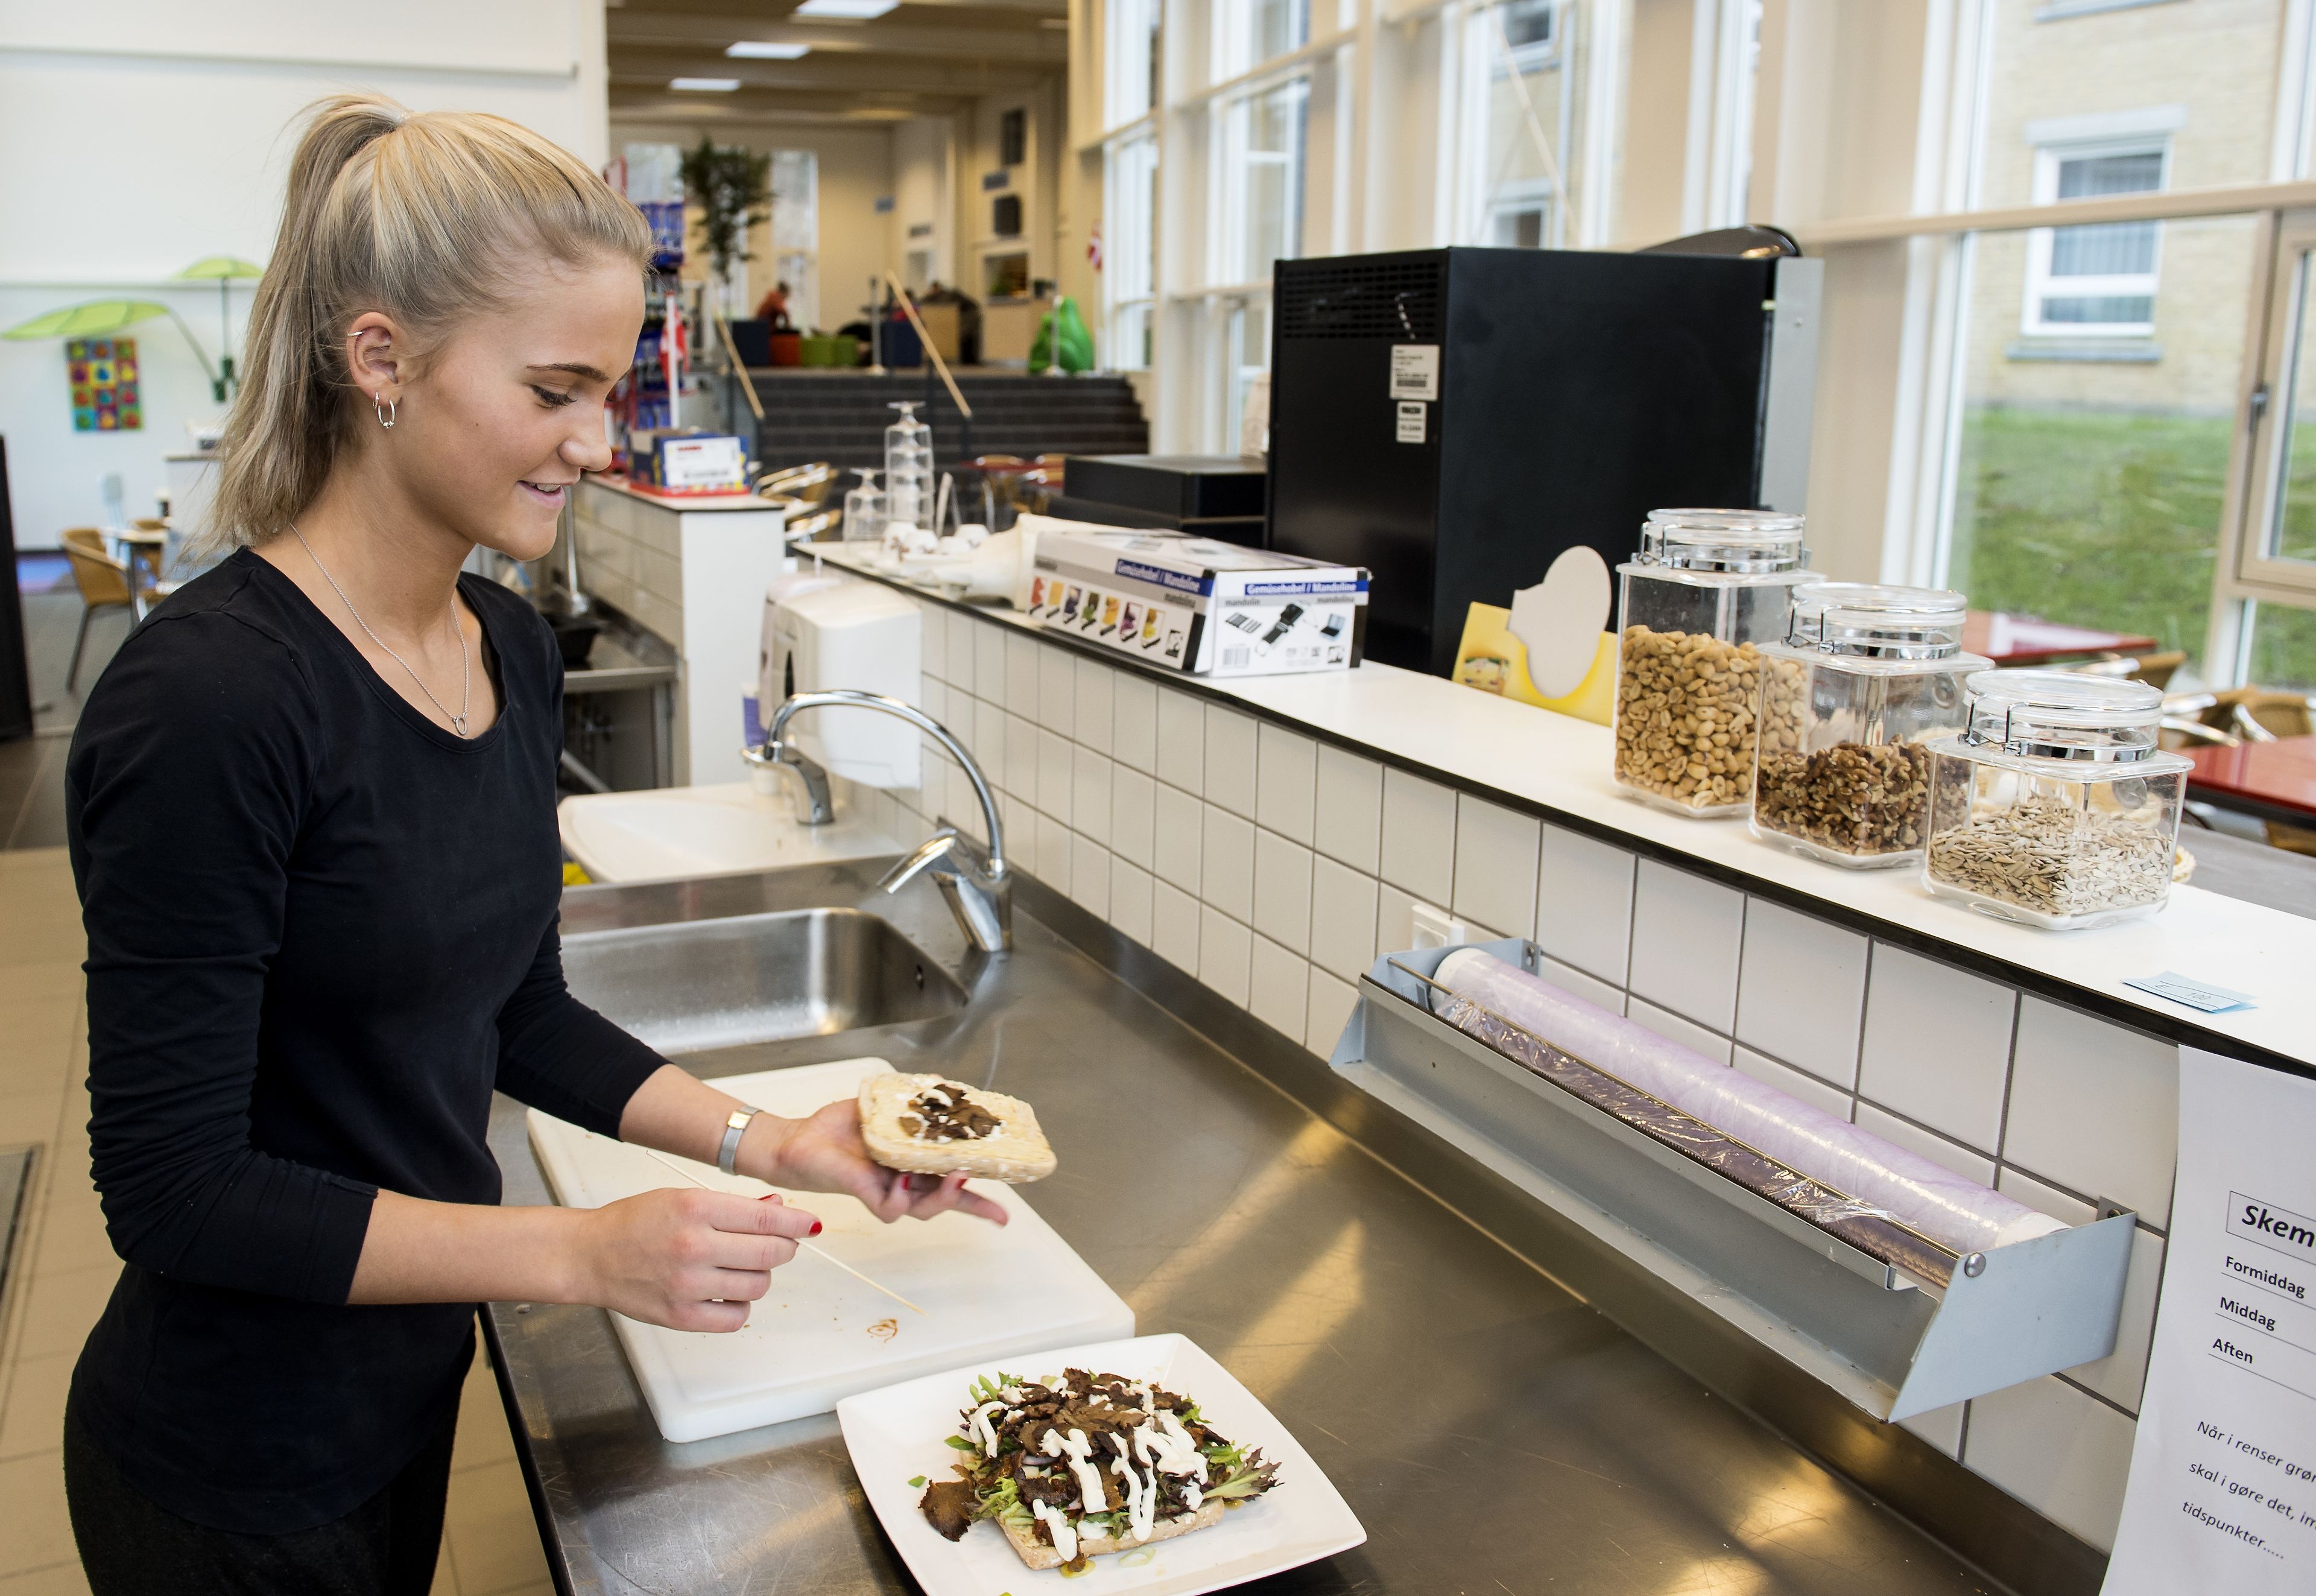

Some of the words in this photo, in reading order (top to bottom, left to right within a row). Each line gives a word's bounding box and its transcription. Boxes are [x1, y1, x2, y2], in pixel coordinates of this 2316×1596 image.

[1312, 580, 1356, 592] Mandoline
[2241, 1205, 2316, 1247] Skem
[2226, 1256, 2305, 1299] Formiddag
[2220, 1297, 2276, 1331] Middag
[2212, 1338, 2253, 1364] Aften
[2197, 1421, 2225, 1440] Når
[2227, 1434, 2233, 1445] i
[2235, 1440, 2283, 1466] renser
[2189, 1463, 2219, 1483] skal
[2220, 1475, 2227, 1486] i
[2229, 1482, 2264, 1503] gøre
[2267, 1498, 2294, 1520] det,
